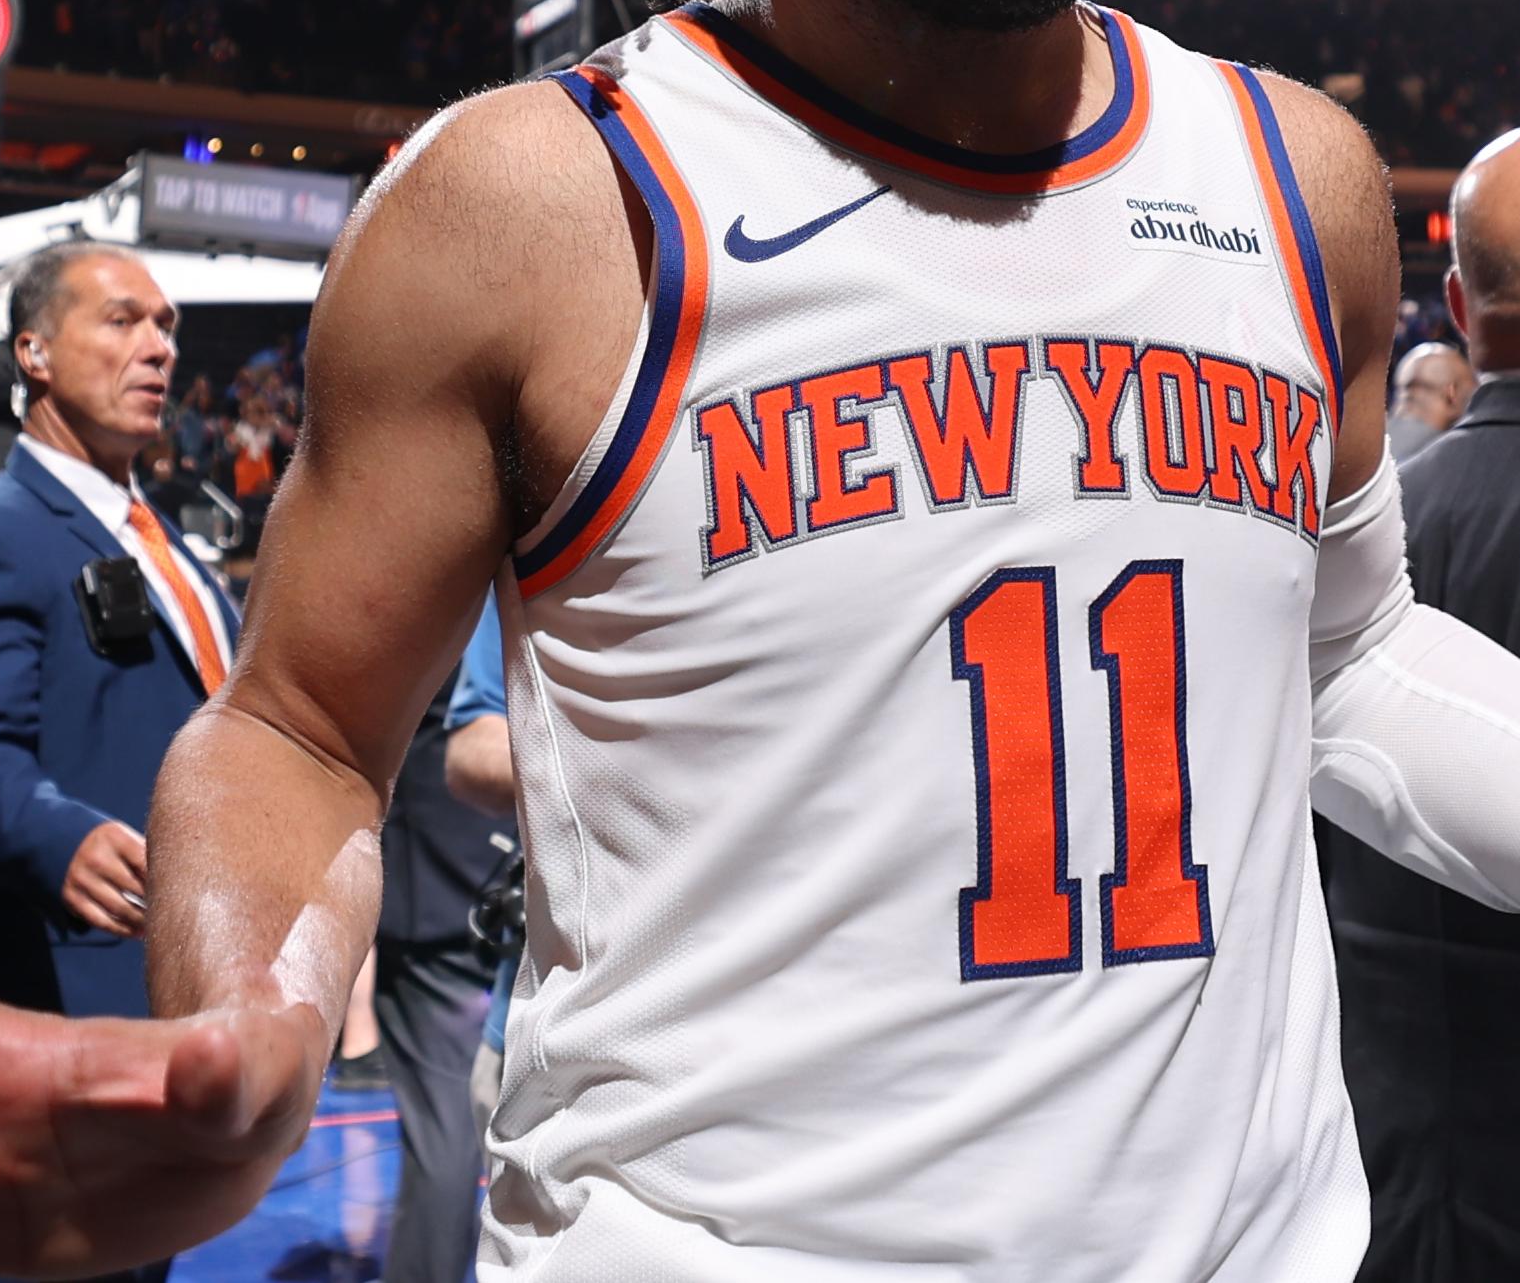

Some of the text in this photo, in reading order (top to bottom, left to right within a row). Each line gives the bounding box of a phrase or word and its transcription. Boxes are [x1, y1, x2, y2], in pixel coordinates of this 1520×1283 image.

[154, 173, 190, 211] TAP
[193, 178, 218, 214] TO
[220, 182, 290, 222] WATCH
[1126, 197, 1199, 216] experience
[1130, 214, 1262, 255] abu dhabi
[691, 333, 1331, 575] NEW YORK
[950, 557, 1216, 982] 11
